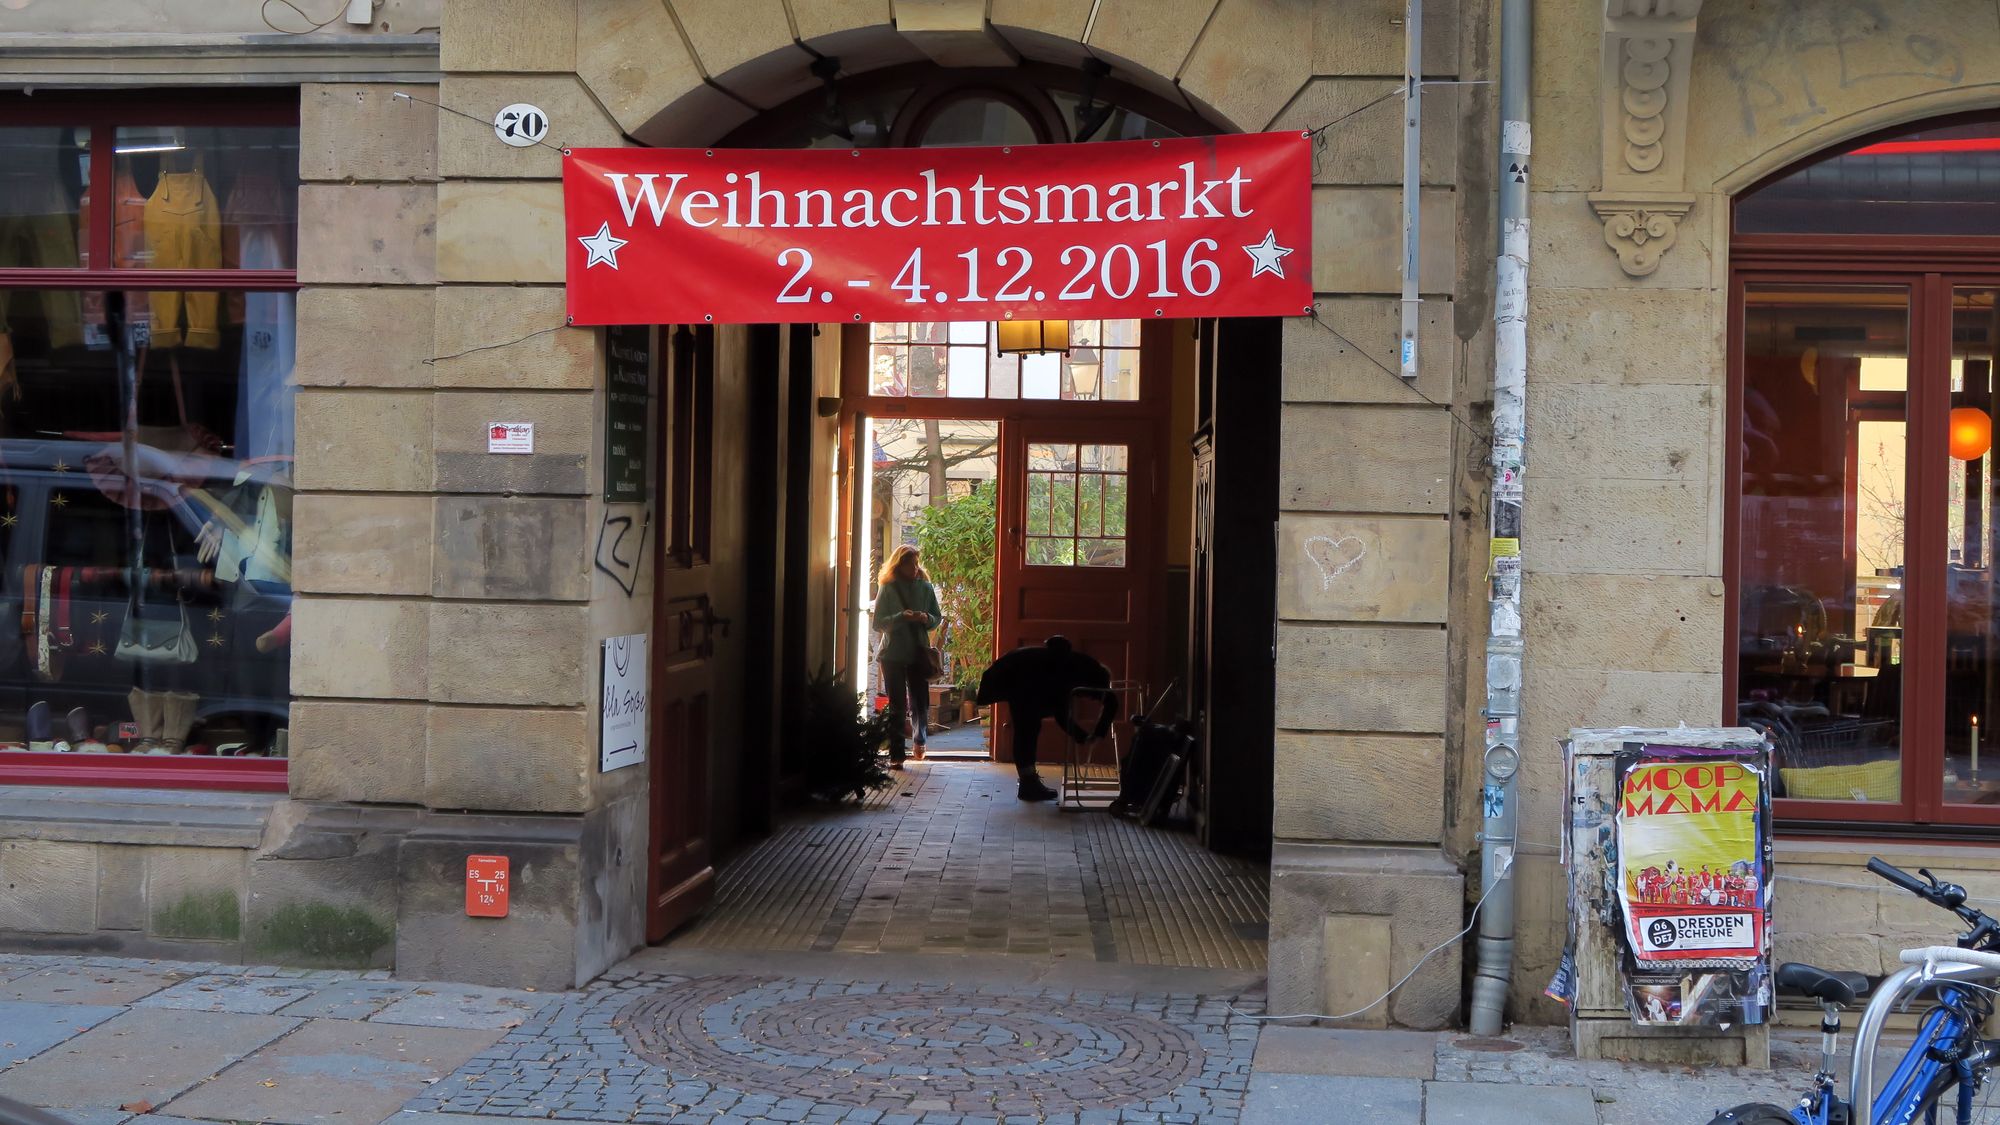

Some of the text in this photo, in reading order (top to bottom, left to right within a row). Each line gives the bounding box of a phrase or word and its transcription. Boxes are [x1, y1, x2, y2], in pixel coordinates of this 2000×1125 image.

[502, 112, 543, 137] 70
[603, 161, 1254, 228] Weihnachtsmarkt
[1626, 765, 1744, 794] MOOP
[1625, 789, 1758, 818] MAMA
[469, 869, 505, 879] ES 25
[495, 884, 505, 892] 14
[479, 894, 494, 904] 124
[1653, 921, 1668, 931] 06
[1677, 916, 1744, 929] DRESDEN
[1653, 933, 1673, 945] DEZ
[1677, 928, 1733, 939] SCHEUNE
